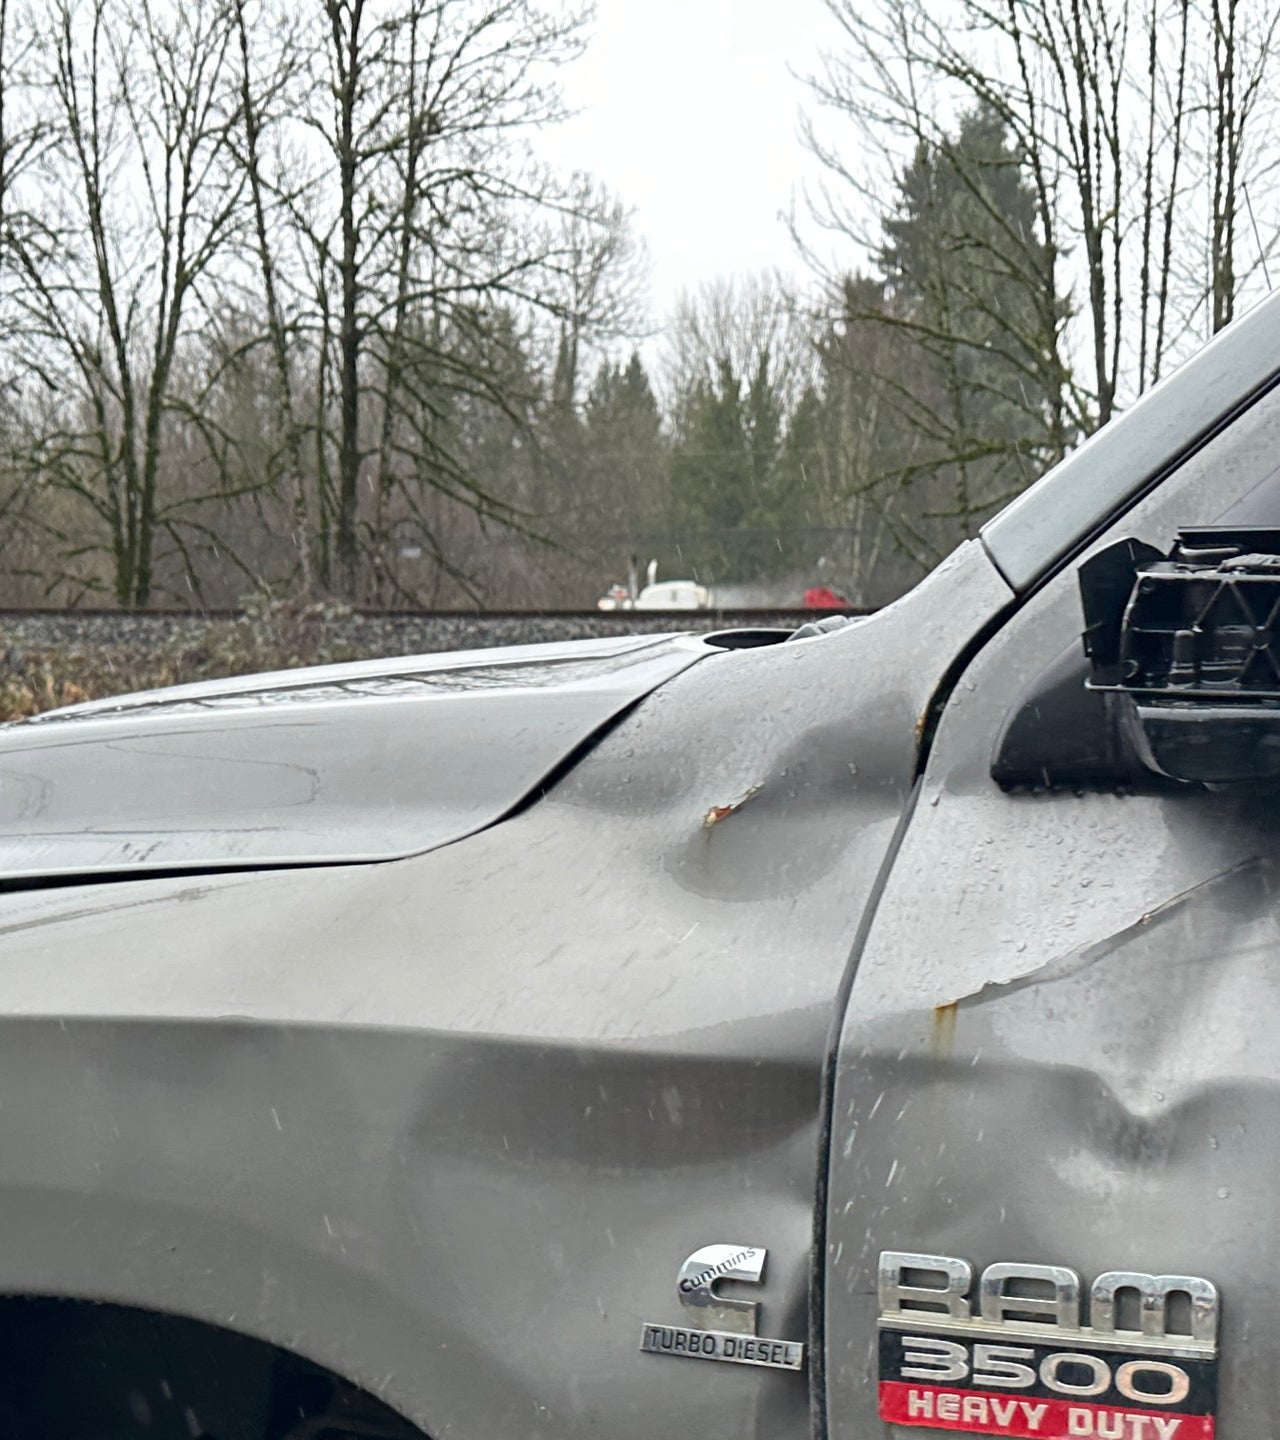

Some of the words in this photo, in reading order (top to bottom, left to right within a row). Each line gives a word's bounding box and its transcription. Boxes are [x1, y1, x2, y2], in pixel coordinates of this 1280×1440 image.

[680, 1247, 757, 1293] Cummins
[877, 1250, 1219, 1346] RAM
[650, 1328, 716, 1355] TURBO
[723, 1338, 795, 1366] DIESEL
[900, 1335, 1191, 1405] 3500
[907, 1389, 1050, 1431] HEAVY
